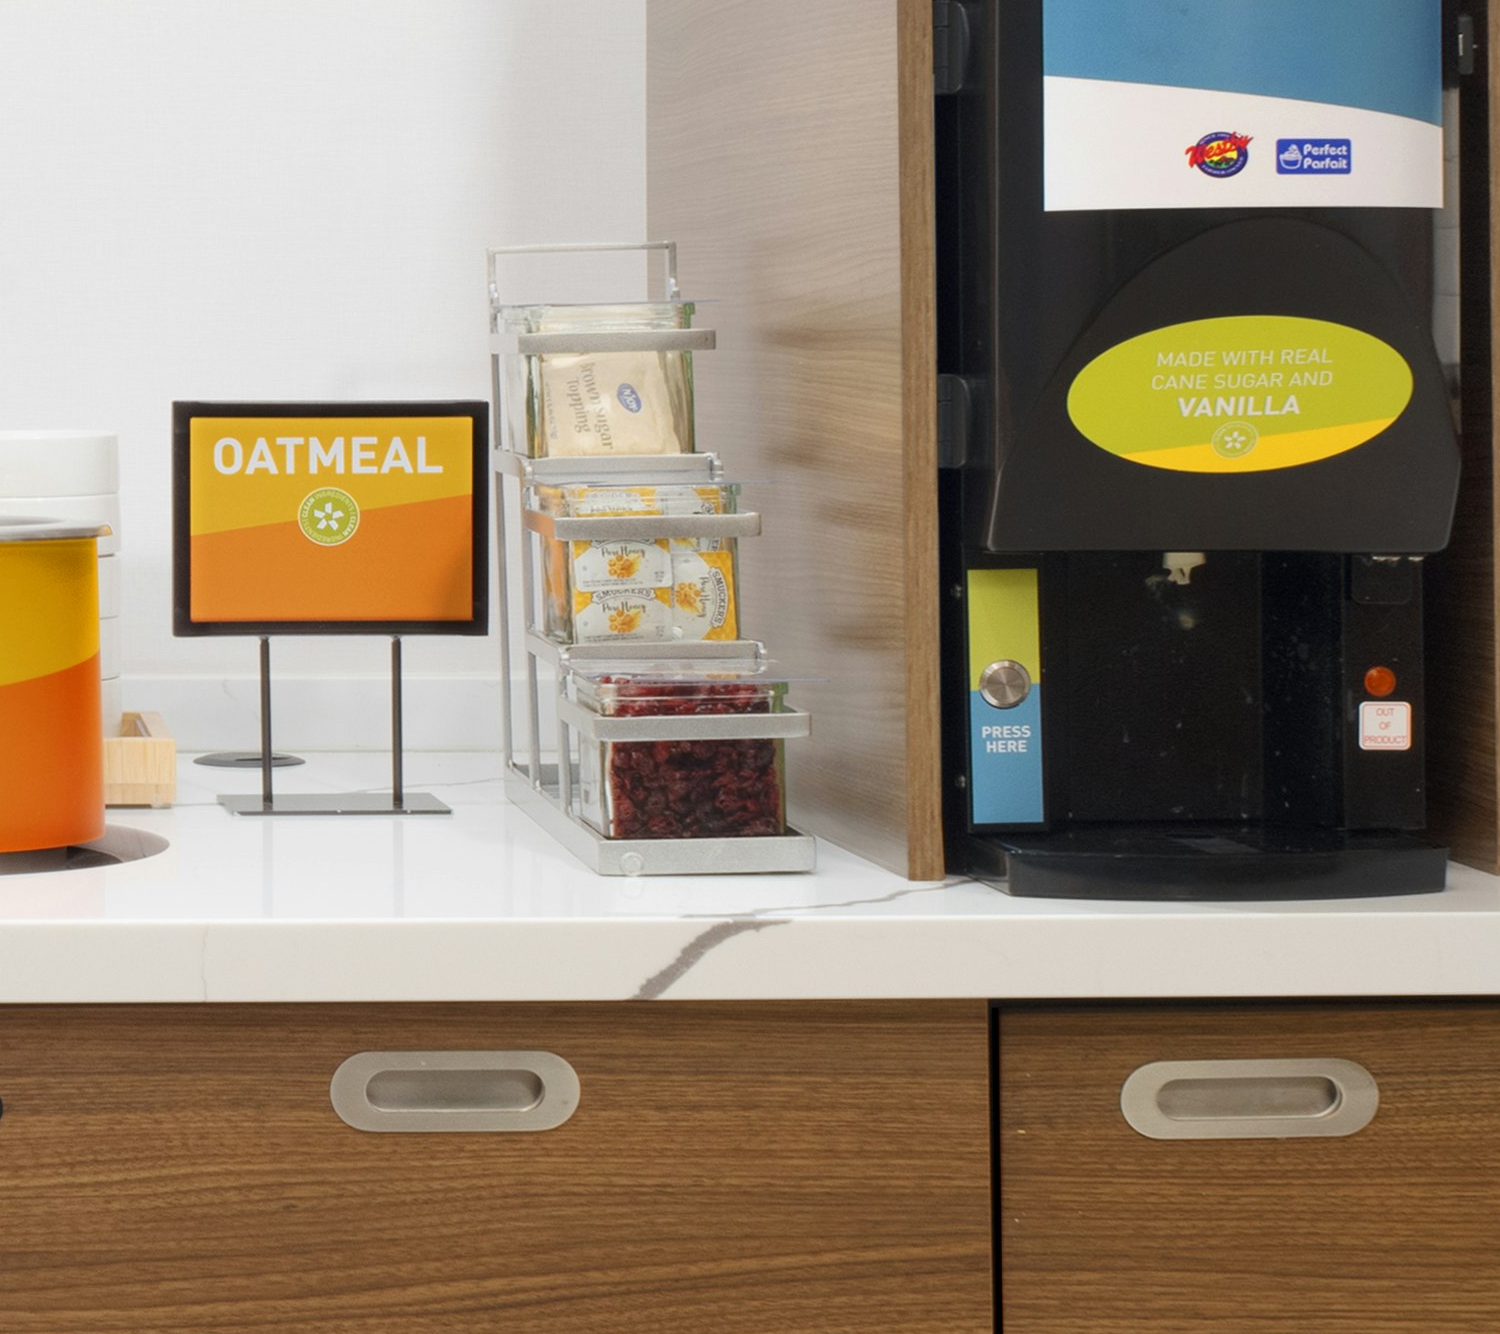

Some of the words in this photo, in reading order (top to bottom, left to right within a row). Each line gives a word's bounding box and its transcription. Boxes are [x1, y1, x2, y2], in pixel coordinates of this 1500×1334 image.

[1303, 144, 1348, 156] Perfect
[1303, 157, 1348, 169] Parfait
[1156, 351, 1217, 367] MADE
[1221, 349, 1275, 366] WITH
[1280, 348, 1333, 364] REAL
[1151, 374, 1208, 390] CANE
[1213, 372, 1284, 389] SUGAR
[1288, 370, 1333, 387] AND
[567, 376, 591, 433] Topping
[1177, 395, 1301, 417] VANILLA
[213, 436, 444, 475] OATMEAL
[1376, 708, 1395, 716] OUT
[982, 725, 1031, 738] PRESS
[1363, 735, 1407, 744] PRODUCT
[986, 740, 1027, 753] HERE
